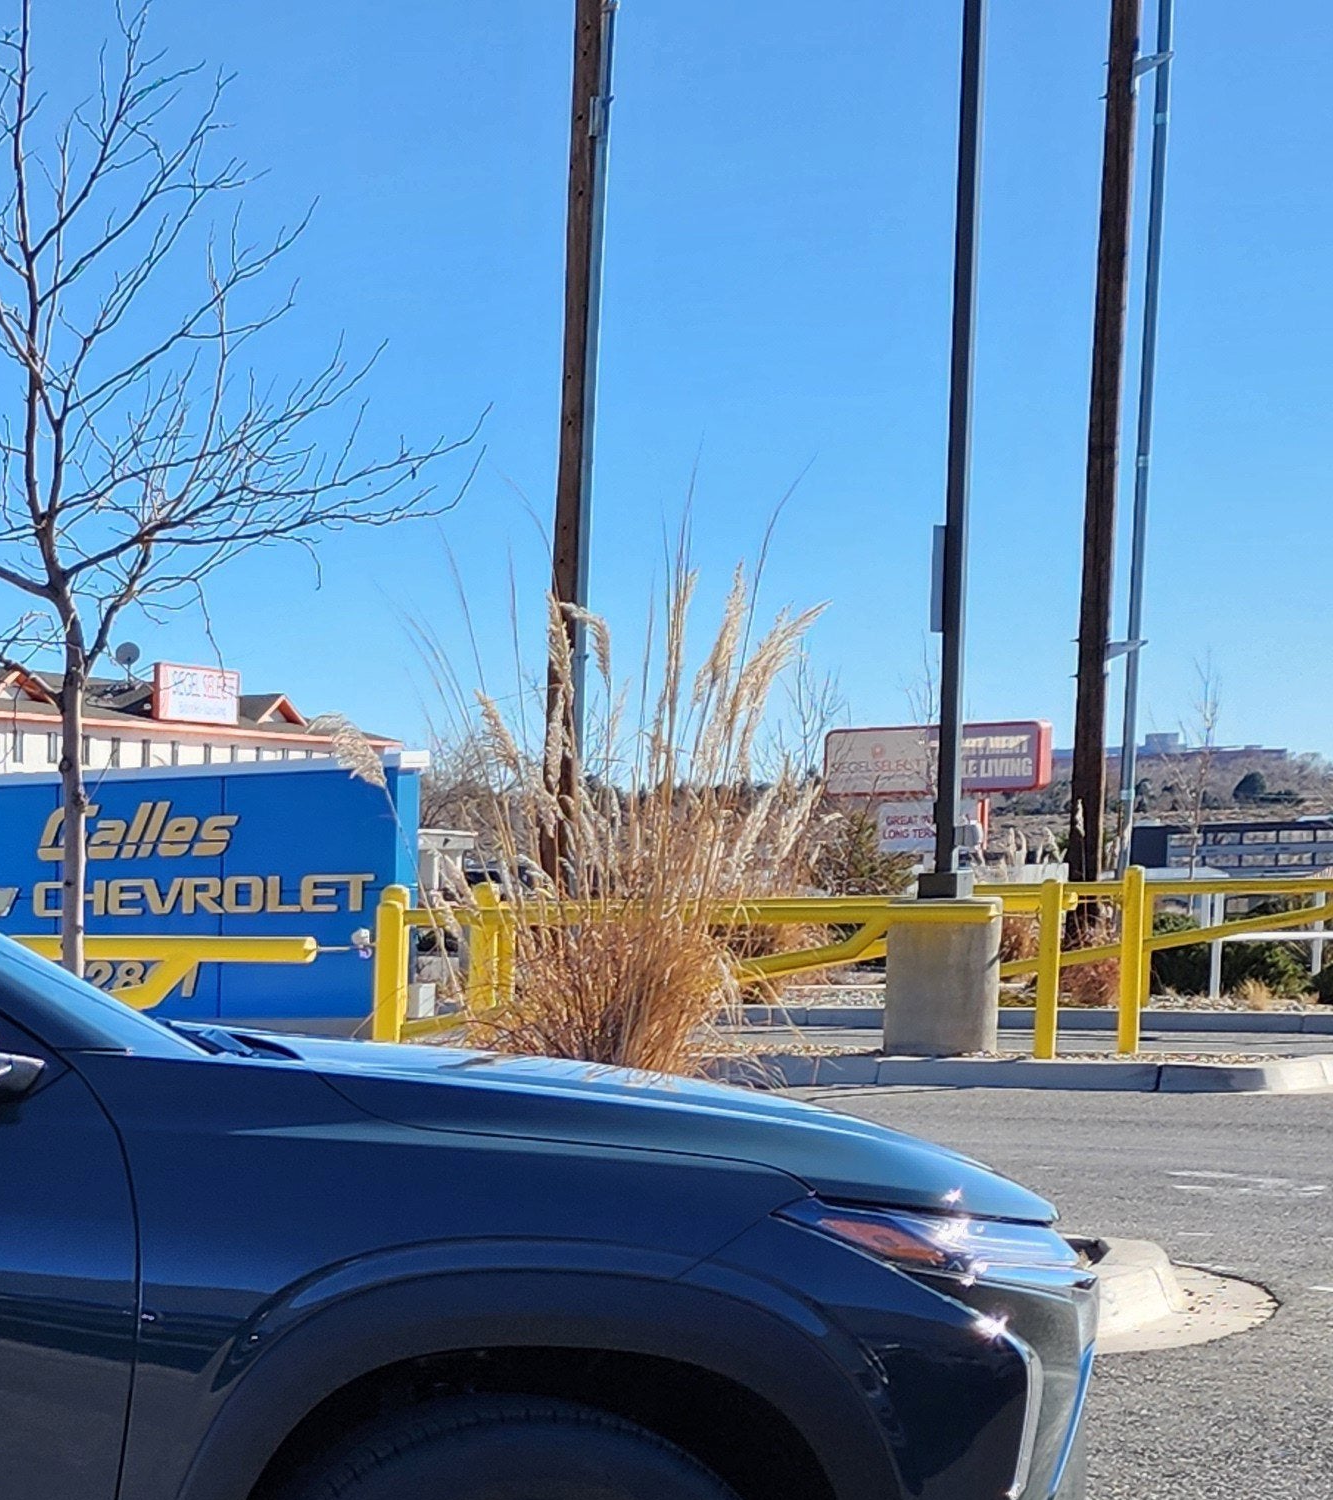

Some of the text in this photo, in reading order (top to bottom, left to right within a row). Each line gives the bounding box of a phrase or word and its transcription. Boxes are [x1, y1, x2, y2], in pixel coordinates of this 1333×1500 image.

[36, 800, 239, 861] Galles
[33, 873, 376, 917] CHEVROLET
[86, 961, 201, 998] 281
